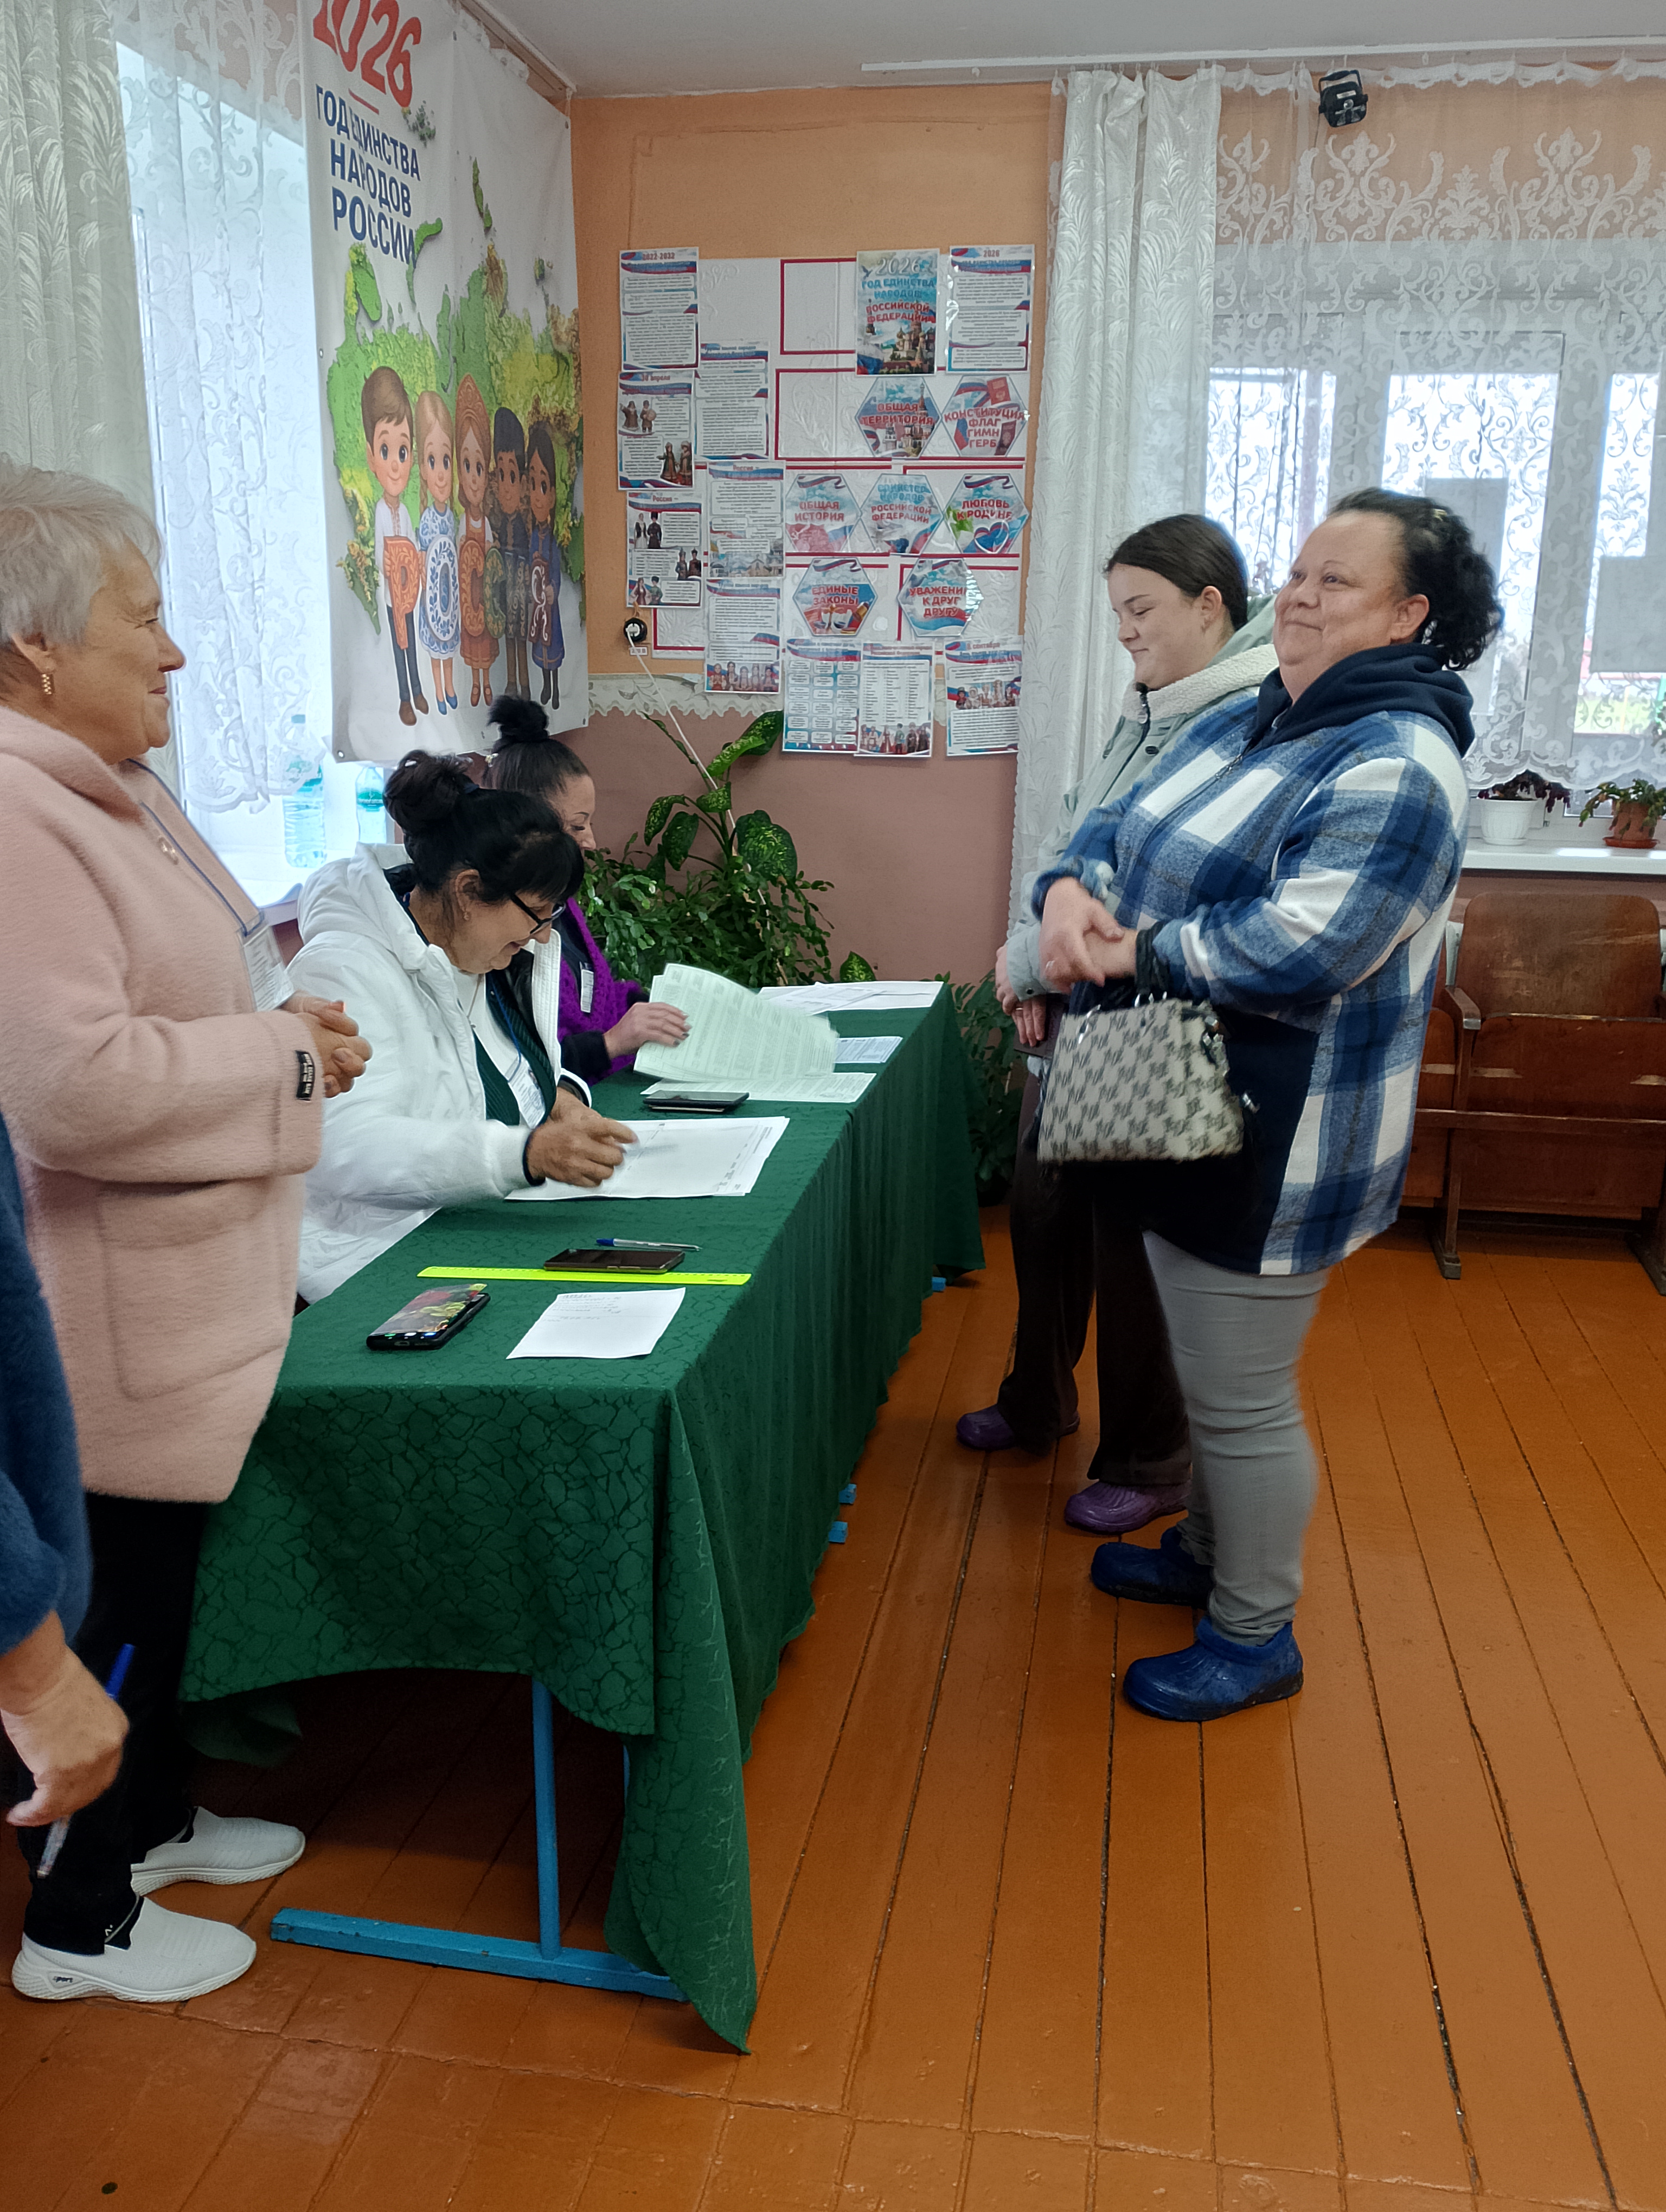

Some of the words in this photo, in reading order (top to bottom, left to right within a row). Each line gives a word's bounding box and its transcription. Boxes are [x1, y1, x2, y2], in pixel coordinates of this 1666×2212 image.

[313, 0, 421, 107] 2026
[316, 83, 350, 140] ГОД
[349, 106, 420, 181] ЕДИНСТВА
[330, 138, 411, 217] НАРОДОВ
[332, 186, 416, 269] РОССИИ
[983, 249, 1000, 258] 2026
[875, 256, 920, 276] 2026
[861, 279, 882, 290] ГОД
[883, 278, 934, 288] ЕДИНСТВА
[874, 290, 922, 299] НАРОДОВ
[866, 299, 930, 314] РОССИЙСКОЙ
[867, 312, 929, 323] ФЕДЕРАЦИИ
[877, 403, 918, 413] ОБЩАЯ
[861, 415, 933, 425] ТЕРРИТОРИЯ
[944, 408, 1024, 423] КОНСТИТУЦИЯ
[969, 418, 1001, 427] ФЛАГ
[967, 428, 999, 437] ГИМН
[969, 439, 997, 448] ГЕРБ
[799, 500, 840, 511] ОБЩАЯ
[962, 499, 1009, 510] ЛЮБОВЬ
[794, 512, 844, 522] ИСТОРИЯ
[872, 512, 929, 524] ФЕДЕРАЦИИ
[957, 511, 965, 520] К
[967, 509, 1013, 520] РОДИНЕ
[812, 586, 858, 595] ЕДИНЫЕ
[813, 596, 858, 606] ЗАКОНЫ
[922, 597, 930, 606] К
[932, 596, 961, 606] ДРУГ
[924, 607, 958, 618] ДРУГУ
